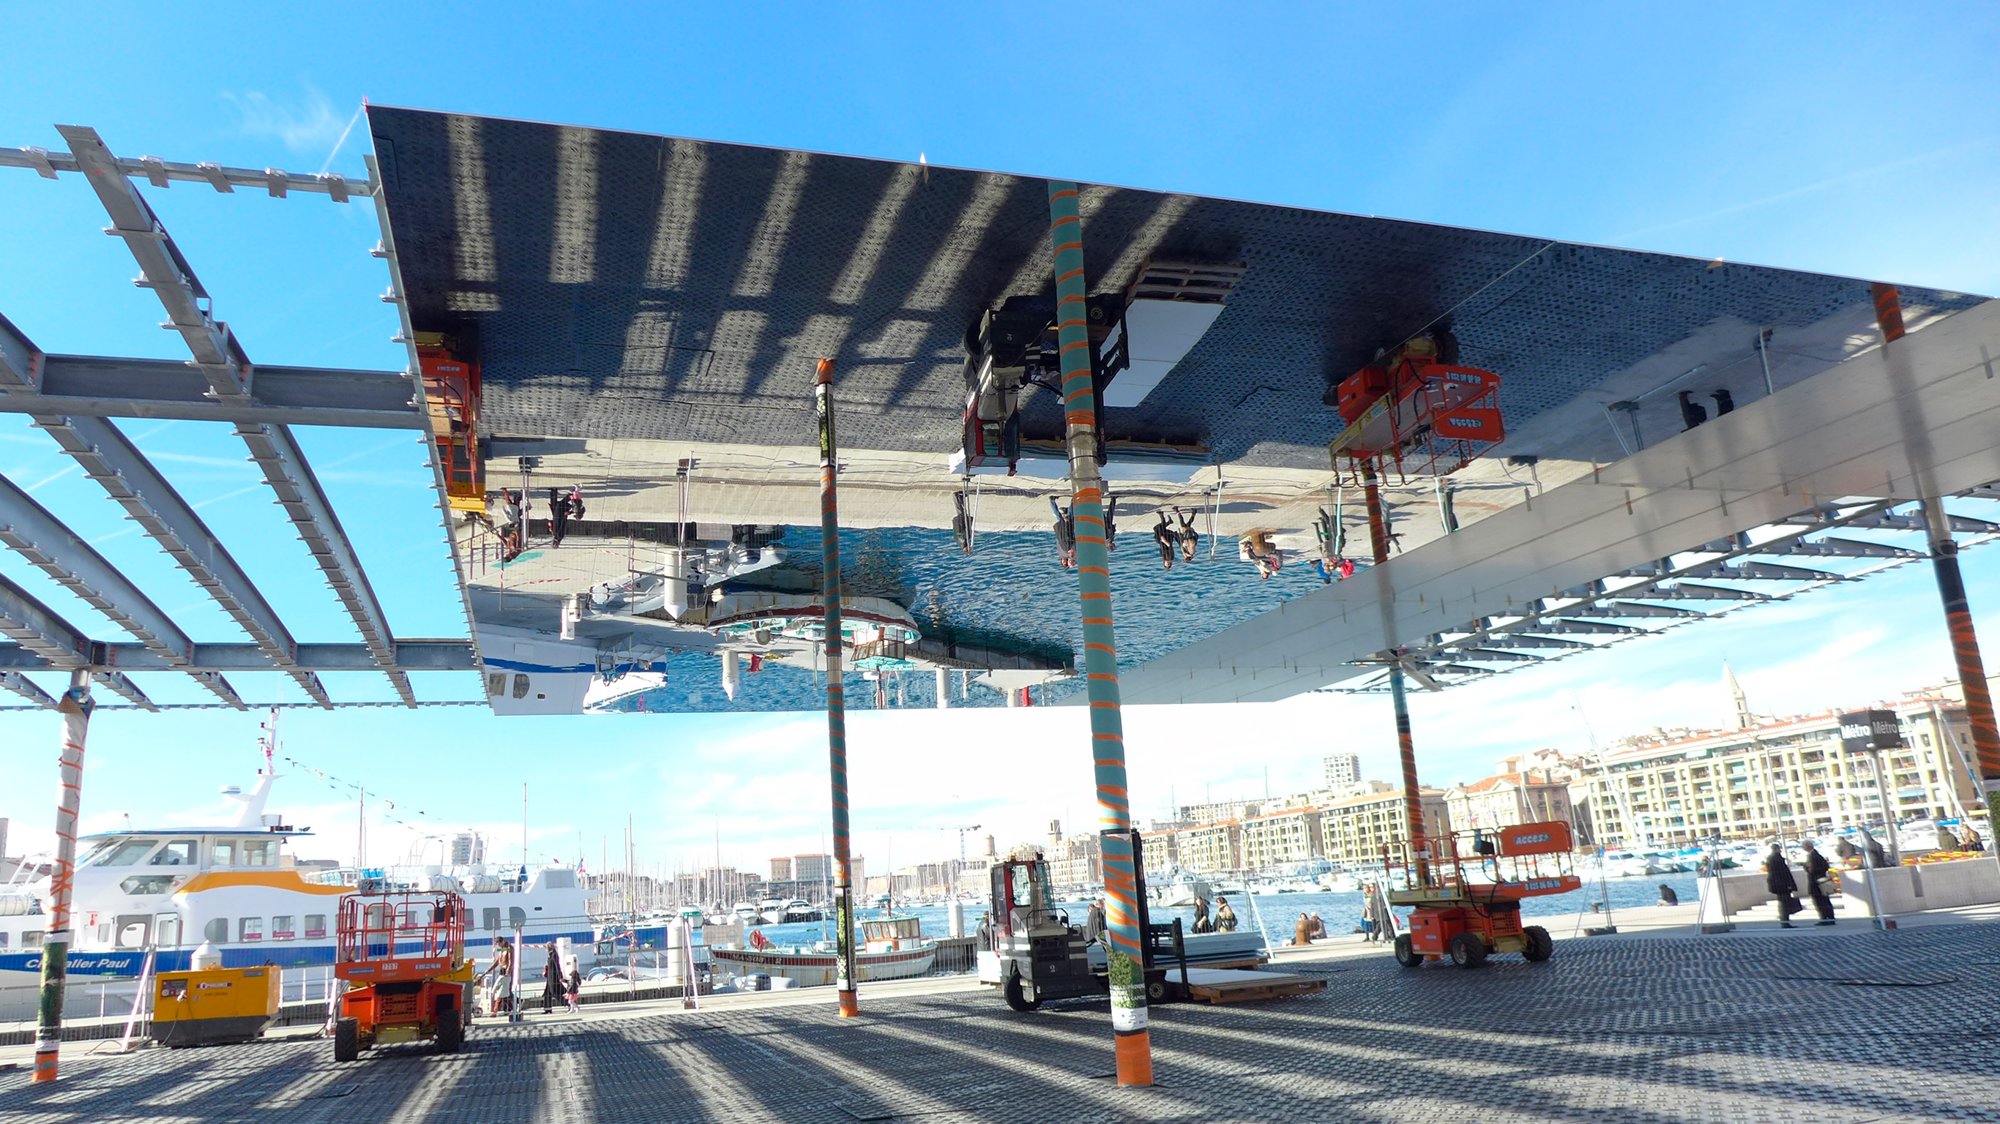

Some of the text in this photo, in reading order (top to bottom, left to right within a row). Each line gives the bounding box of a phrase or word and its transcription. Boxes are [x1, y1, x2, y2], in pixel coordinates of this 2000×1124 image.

[1840, 723, 1870, 739] Métro
[1872, 720, 1898, 735] Métro
[97, 958, 131, 969] Paul
